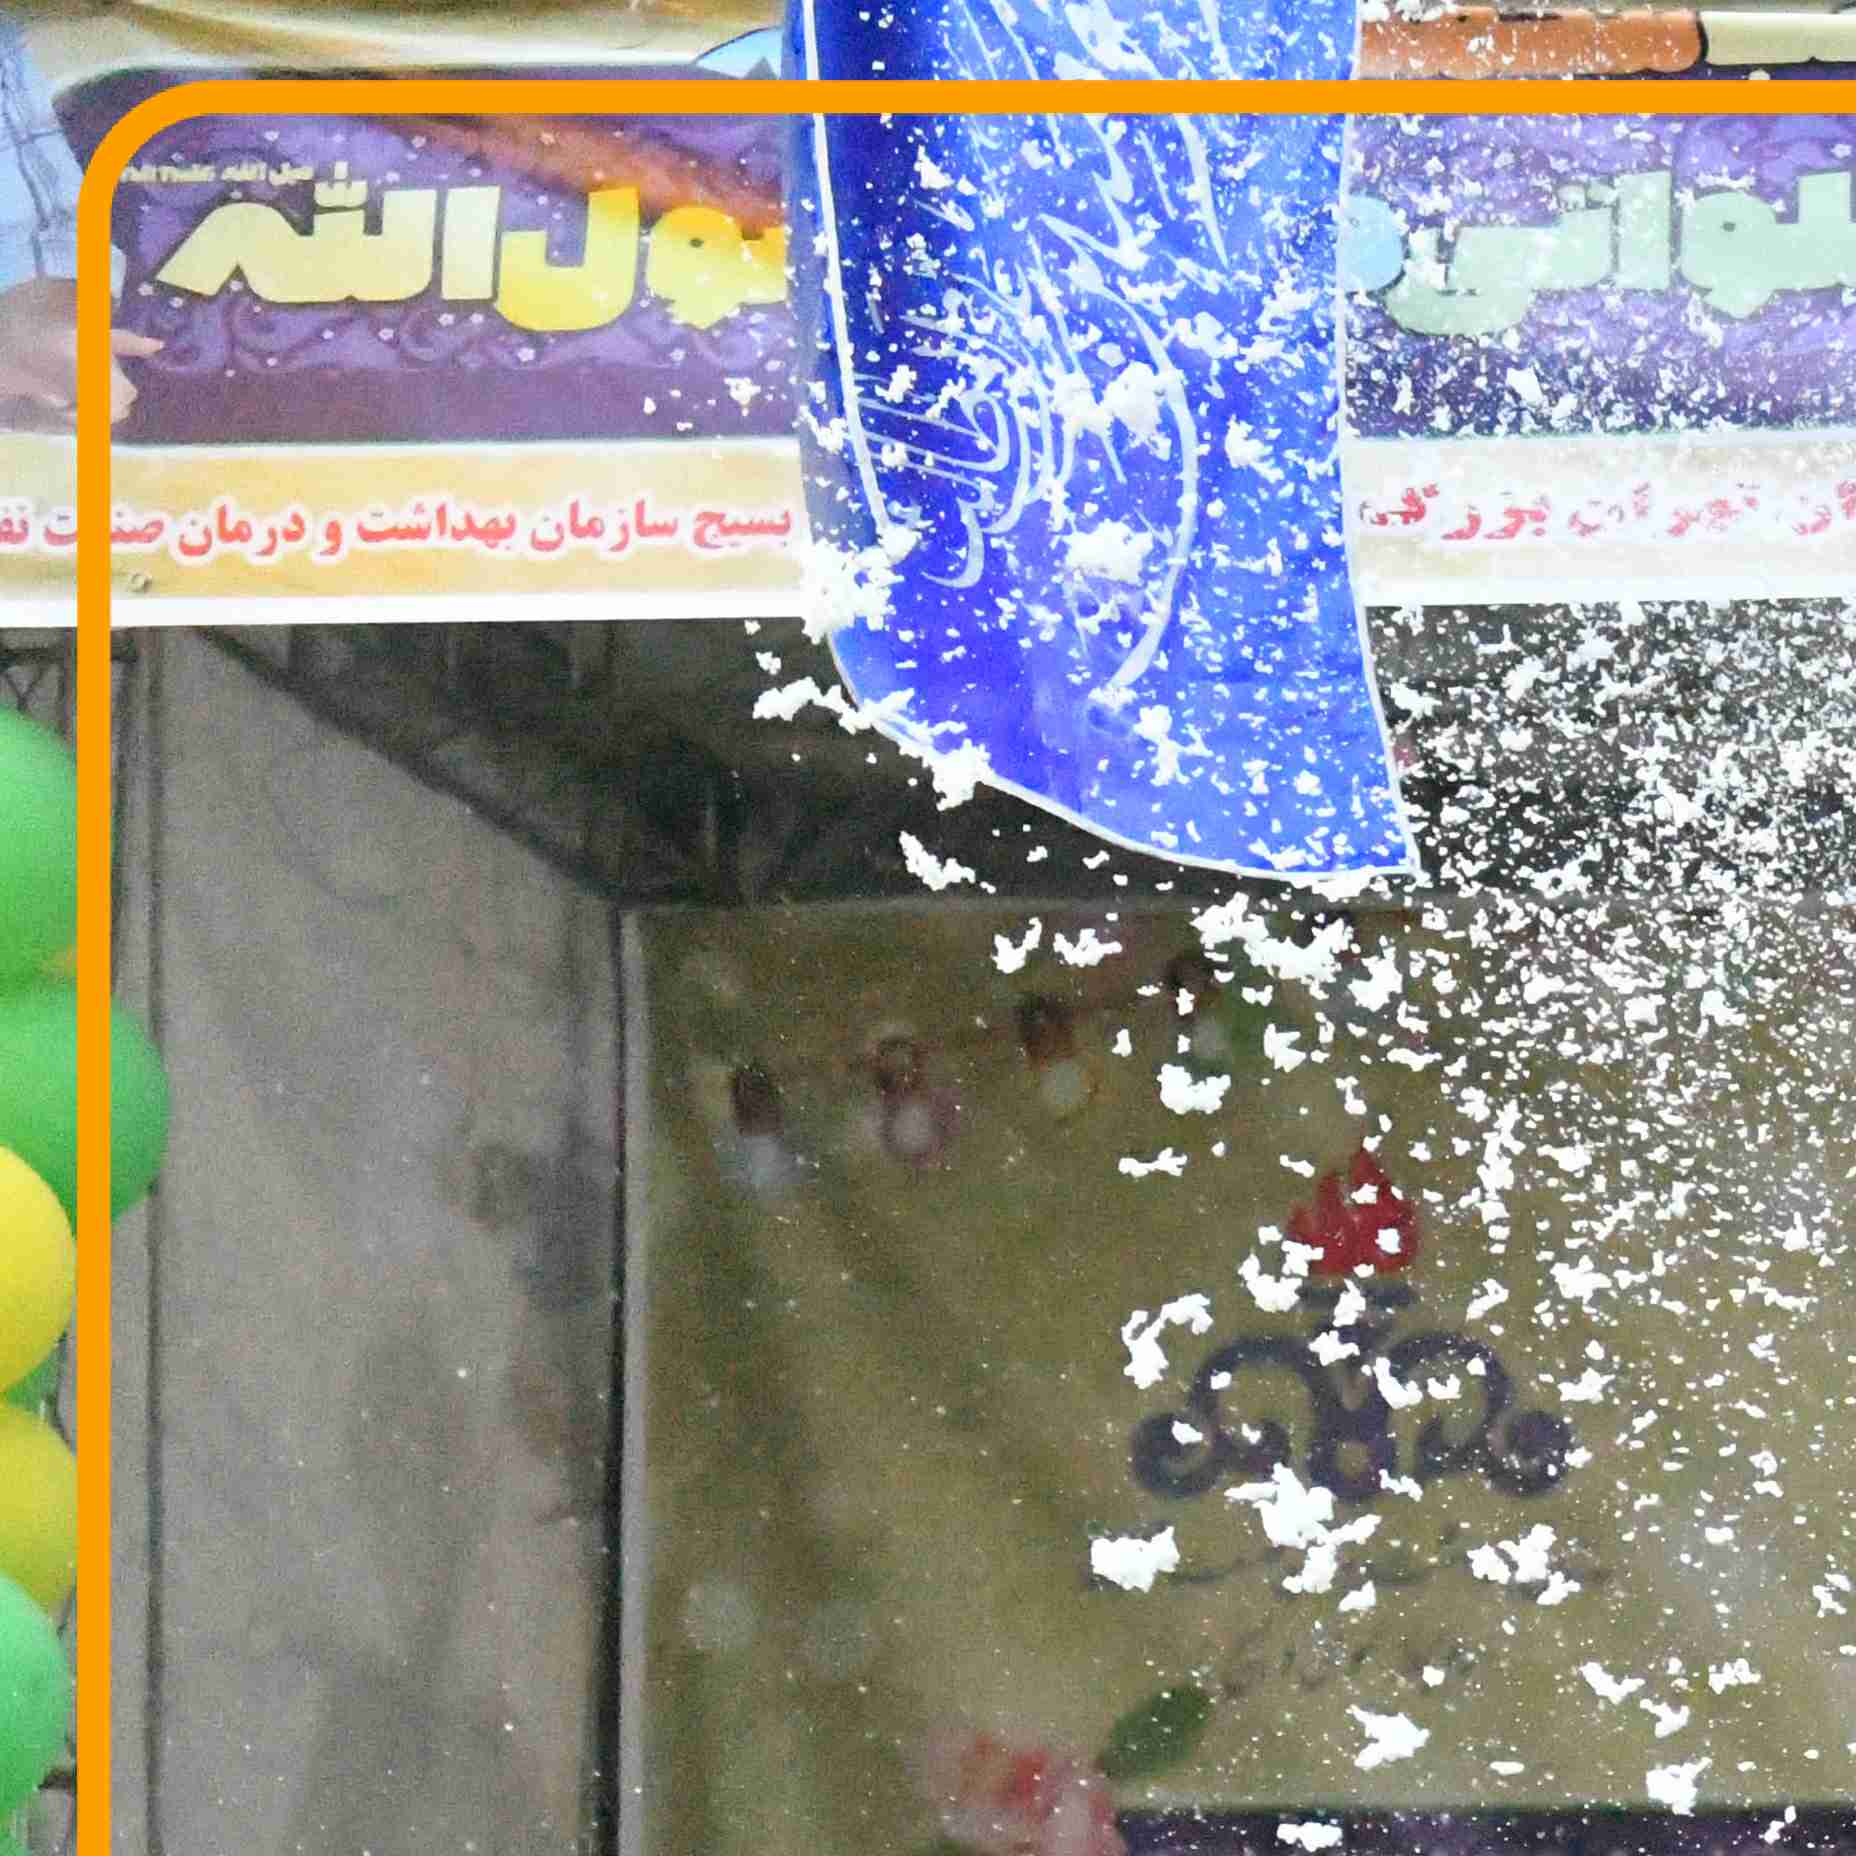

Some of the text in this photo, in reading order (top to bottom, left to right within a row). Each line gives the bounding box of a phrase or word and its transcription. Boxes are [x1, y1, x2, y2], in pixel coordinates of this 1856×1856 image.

[153, 160, 499, 304] الله
[44, 510, 165, 546] صنت
[178, 503, 305, 558] درمان
[319, 518, 342, 557] و
[356, 501, 517, 547] بهداشت
[530, 501, 680, 557] سازمان
[693, 504, 792, 549] بسیج
